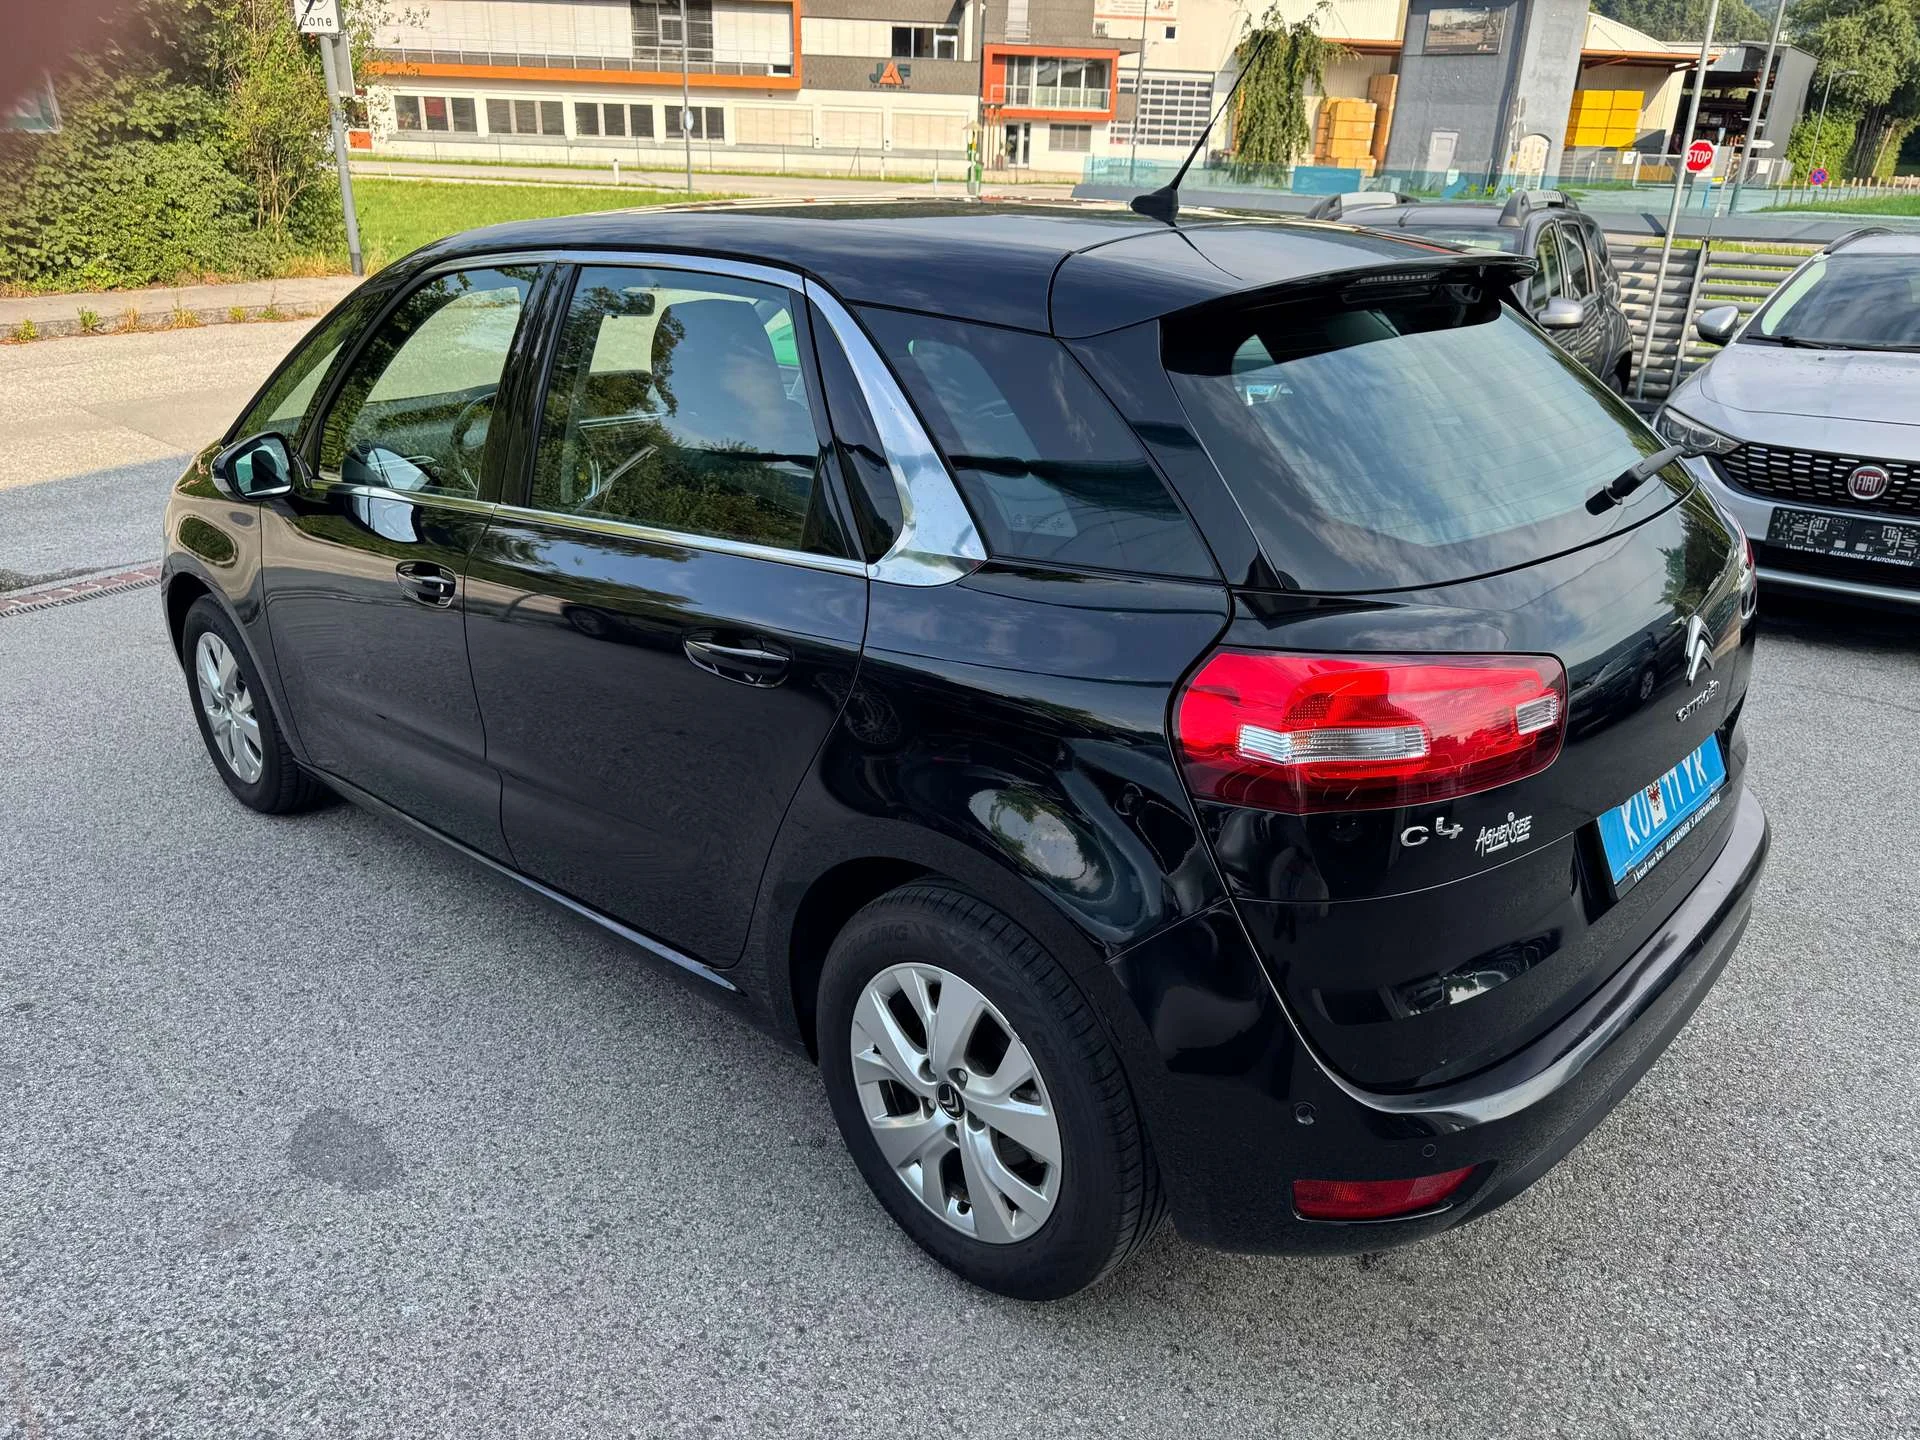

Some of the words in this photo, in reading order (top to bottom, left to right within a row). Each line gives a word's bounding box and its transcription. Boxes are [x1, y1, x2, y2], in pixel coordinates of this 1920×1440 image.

[300, 13, 332, 27] Zone
[868, 60, 912, 85] JAF
[1687, 149, 1712, 164] STOP
[1855, 475, 1881, 492] FIAT
[1872, 556, 1914, 567] AUTOMOBILE
[1620, 790, 1650, 850] KU
[1665, 821, 1691, 852] ALEXANDER
[1694, 793, 1721, 825] AUTOMOBILE
